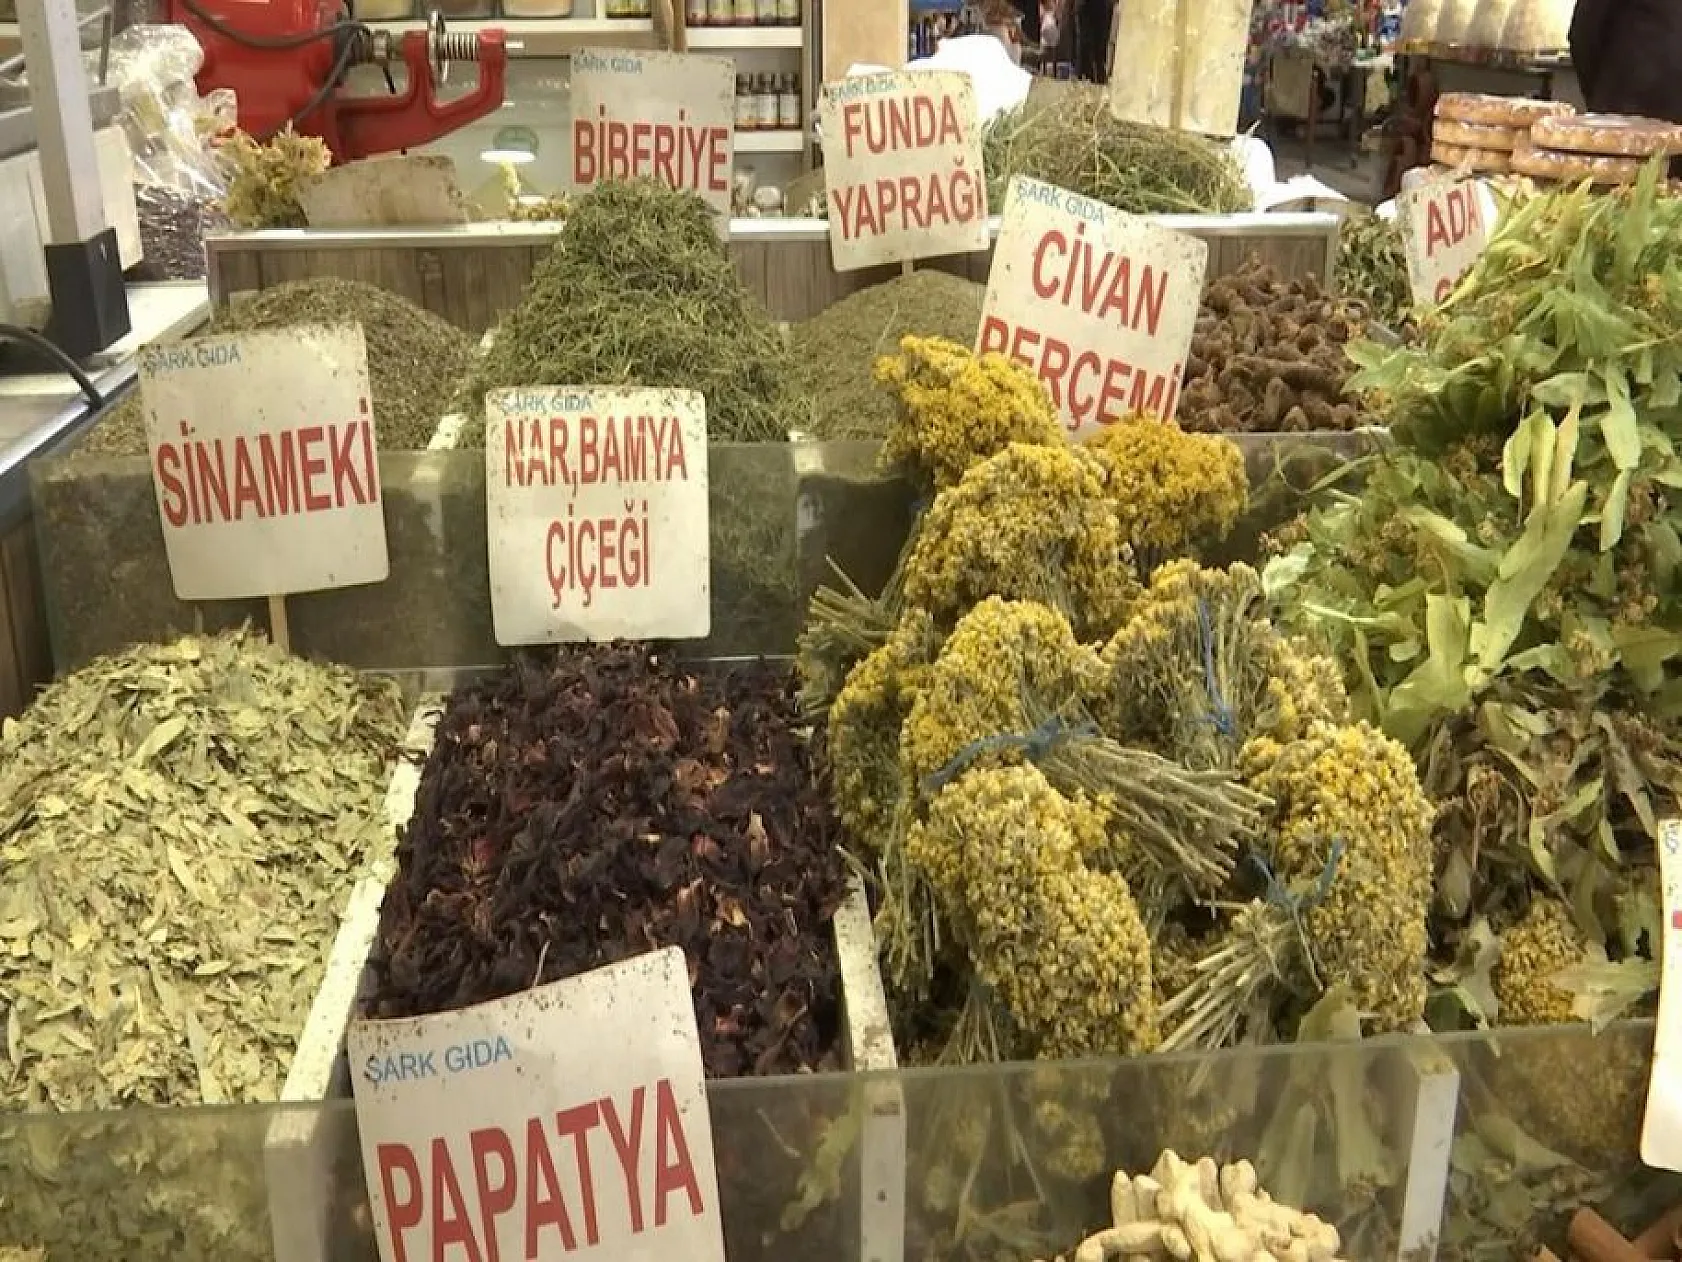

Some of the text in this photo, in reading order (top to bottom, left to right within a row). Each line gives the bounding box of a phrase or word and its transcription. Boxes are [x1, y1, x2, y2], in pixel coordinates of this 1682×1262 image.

[573, 103, 729, 192] BİBERİYE
[843, 94, 963, 159] FUNDA
[1065, 196, 1105, 225] GIDA
[1427, 182, 1479, 257] ADA
[1031, 221, 1169, 338] CİVAN
[196, 343, 242, 368] GIDA
[551, 395, 592, 412] GIDA
[157, 396, 377, 528] SİNAMEKİ
[505, 416, 688, 498] NAR,BAMYA
[546, 499, 650, 609] ÇİÇEĞİ
[364, 1035, 513, 1086] ŞARK GIDA
[376, 1078, 704, 1262] PAPATYA
